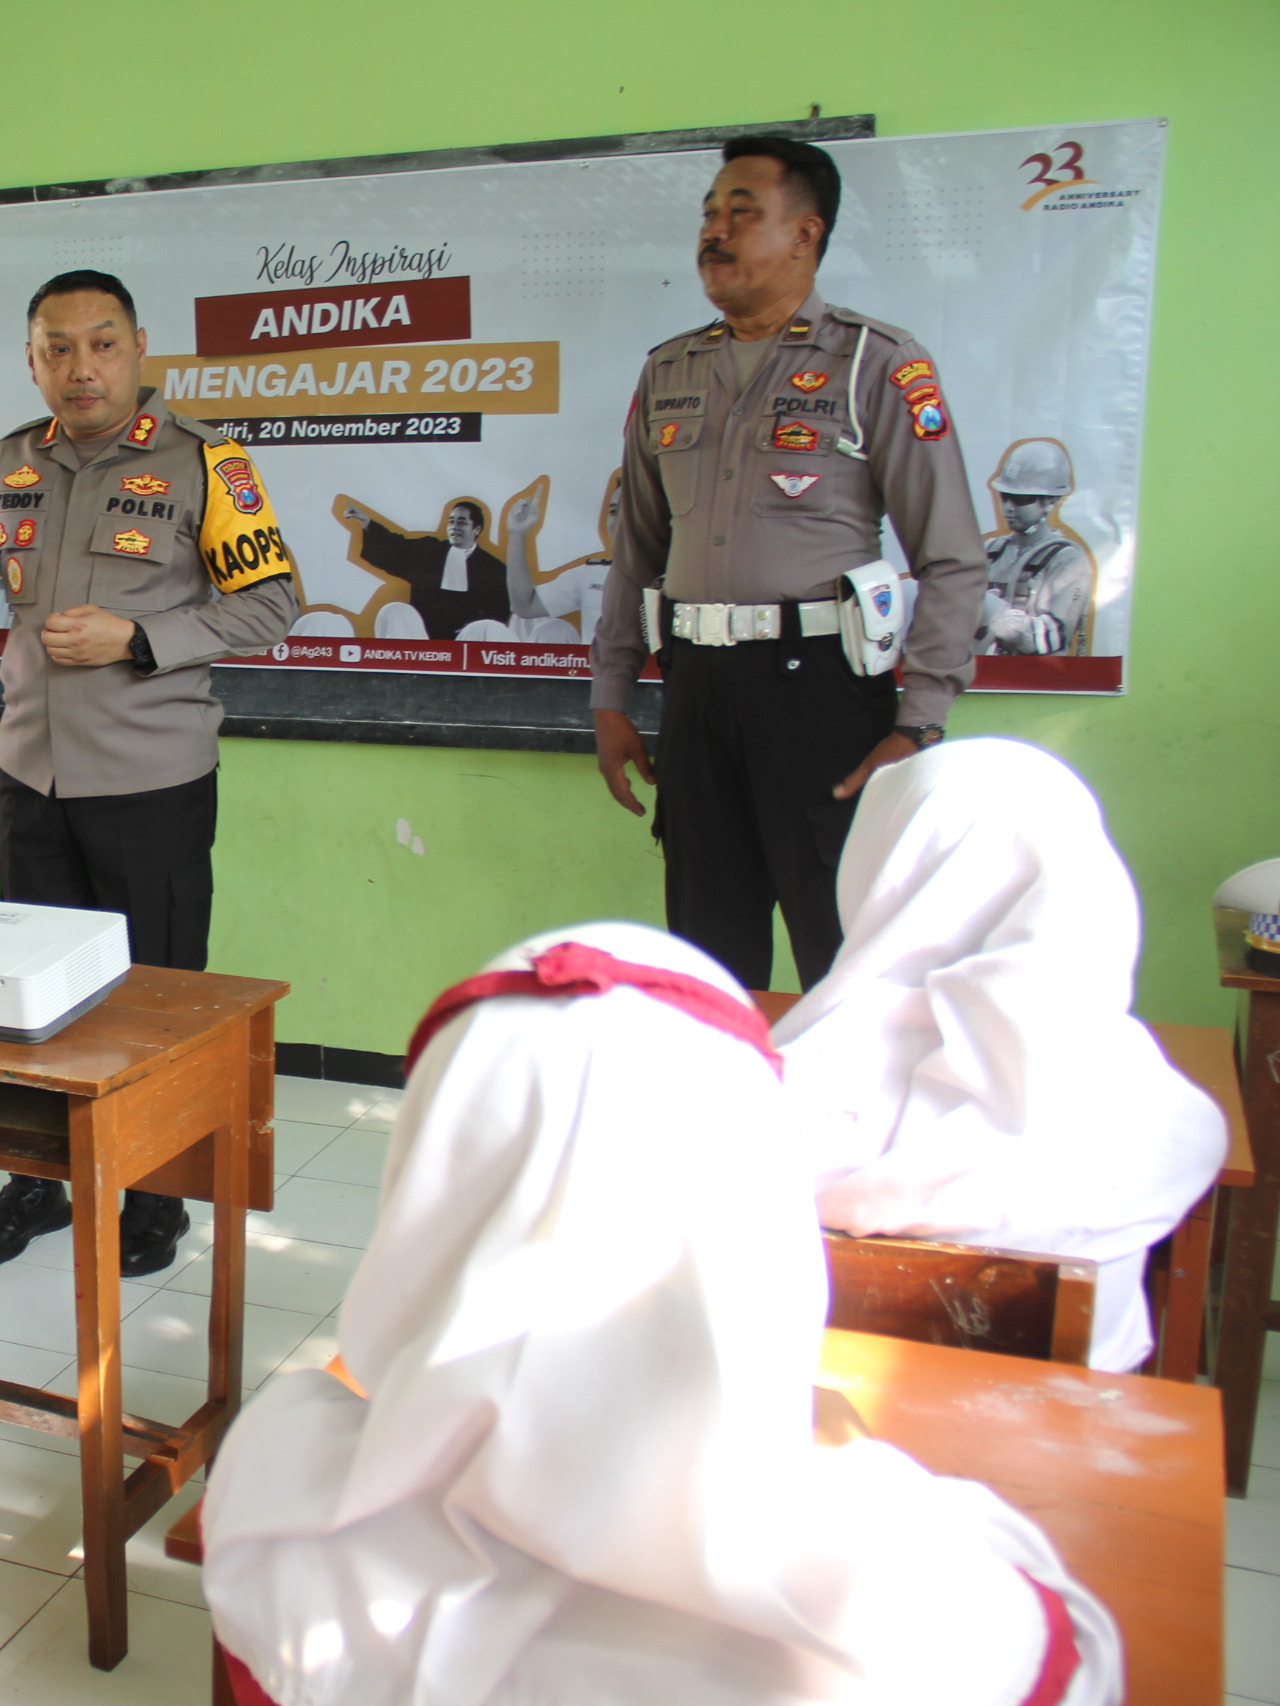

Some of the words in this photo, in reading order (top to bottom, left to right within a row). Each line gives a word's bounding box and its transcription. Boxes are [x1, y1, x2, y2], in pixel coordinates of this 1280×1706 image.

[1017, 141, 1085, 188] 23
[1059, 190, 1140, 200] ANNIVERSARY
[1080, 201, 1124, 209] ANDIKA
[256, 242, 323, 286] Kelas
[324, 240, 453, 284] Inspirasi
[250, 295, 412, 340] ANDIKA
[163, 359, 412, 401] MENGAJAR
[420, 357, 535, 393] 2023
[772, 397, 837, 415] POLRI
[258, 421, 286, 439] 20
[291, 417, 401, 438] November
[404, 416, 461, 436] 2023
[106, 497, 175, 521] POLRI
[205, 526, 289, 585] KAOPS
[291, 645, 334, 659] @Ag243
[363, 650, 402, 660] ANDIKA
[403, 650, 418, 660] TV
[418, 651, 452, 662] KEDIRI
[481, 650, 516, 666] Visit
